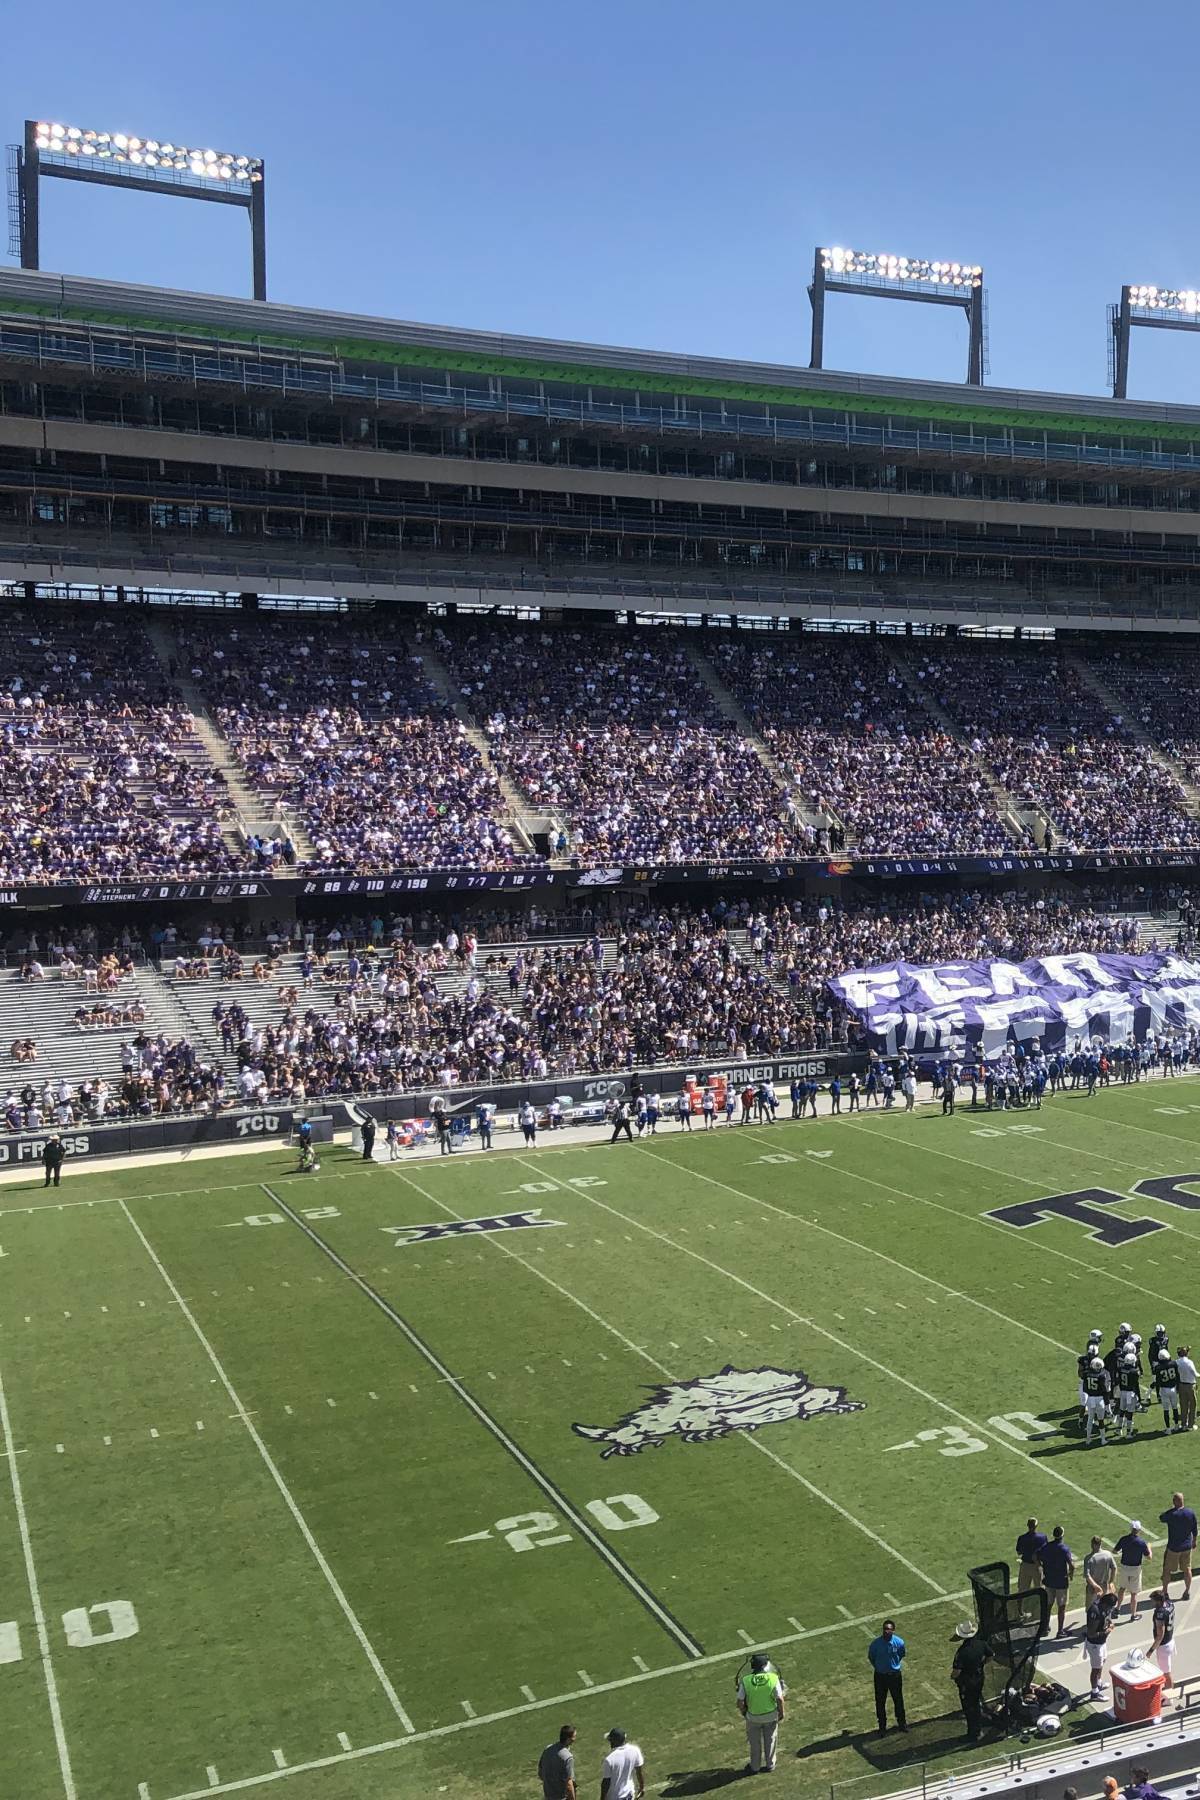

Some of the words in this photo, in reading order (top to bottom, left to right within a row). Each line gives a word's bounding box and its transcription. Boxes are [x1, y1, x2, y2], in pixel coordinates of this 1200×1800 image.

[160, 886, 169, 897] 0
[240, 884, 258, 895] 38
[367, 880, 384, 891] 110
[407, 879, 428, 889] 198
[0, 892, 17, 903] ILK
[714, 1066, 774, 1083] ORNED
[779, 1061, 827, 1078] FROGS
[236, 1115, 280, 1136] TCU
[970, 1124, 1046, 1138] 50
[17, 1136, 90, 1160] FRGS
[759, 1149, 834, 1164] 40
[519, 1175, 609, 1194] 30
[243, 1205, 342, 1227] 20
[1120, 1373, 1129, 1387] 9
[1160, 1367, 1177, 1383] 38
[1087, 1376, 1099, 1391] 15
[915, 1411, 1057, 1457] 30
[494, 1493, 660, 1553] 20
[1114, 1686, 1127, 1711] G
